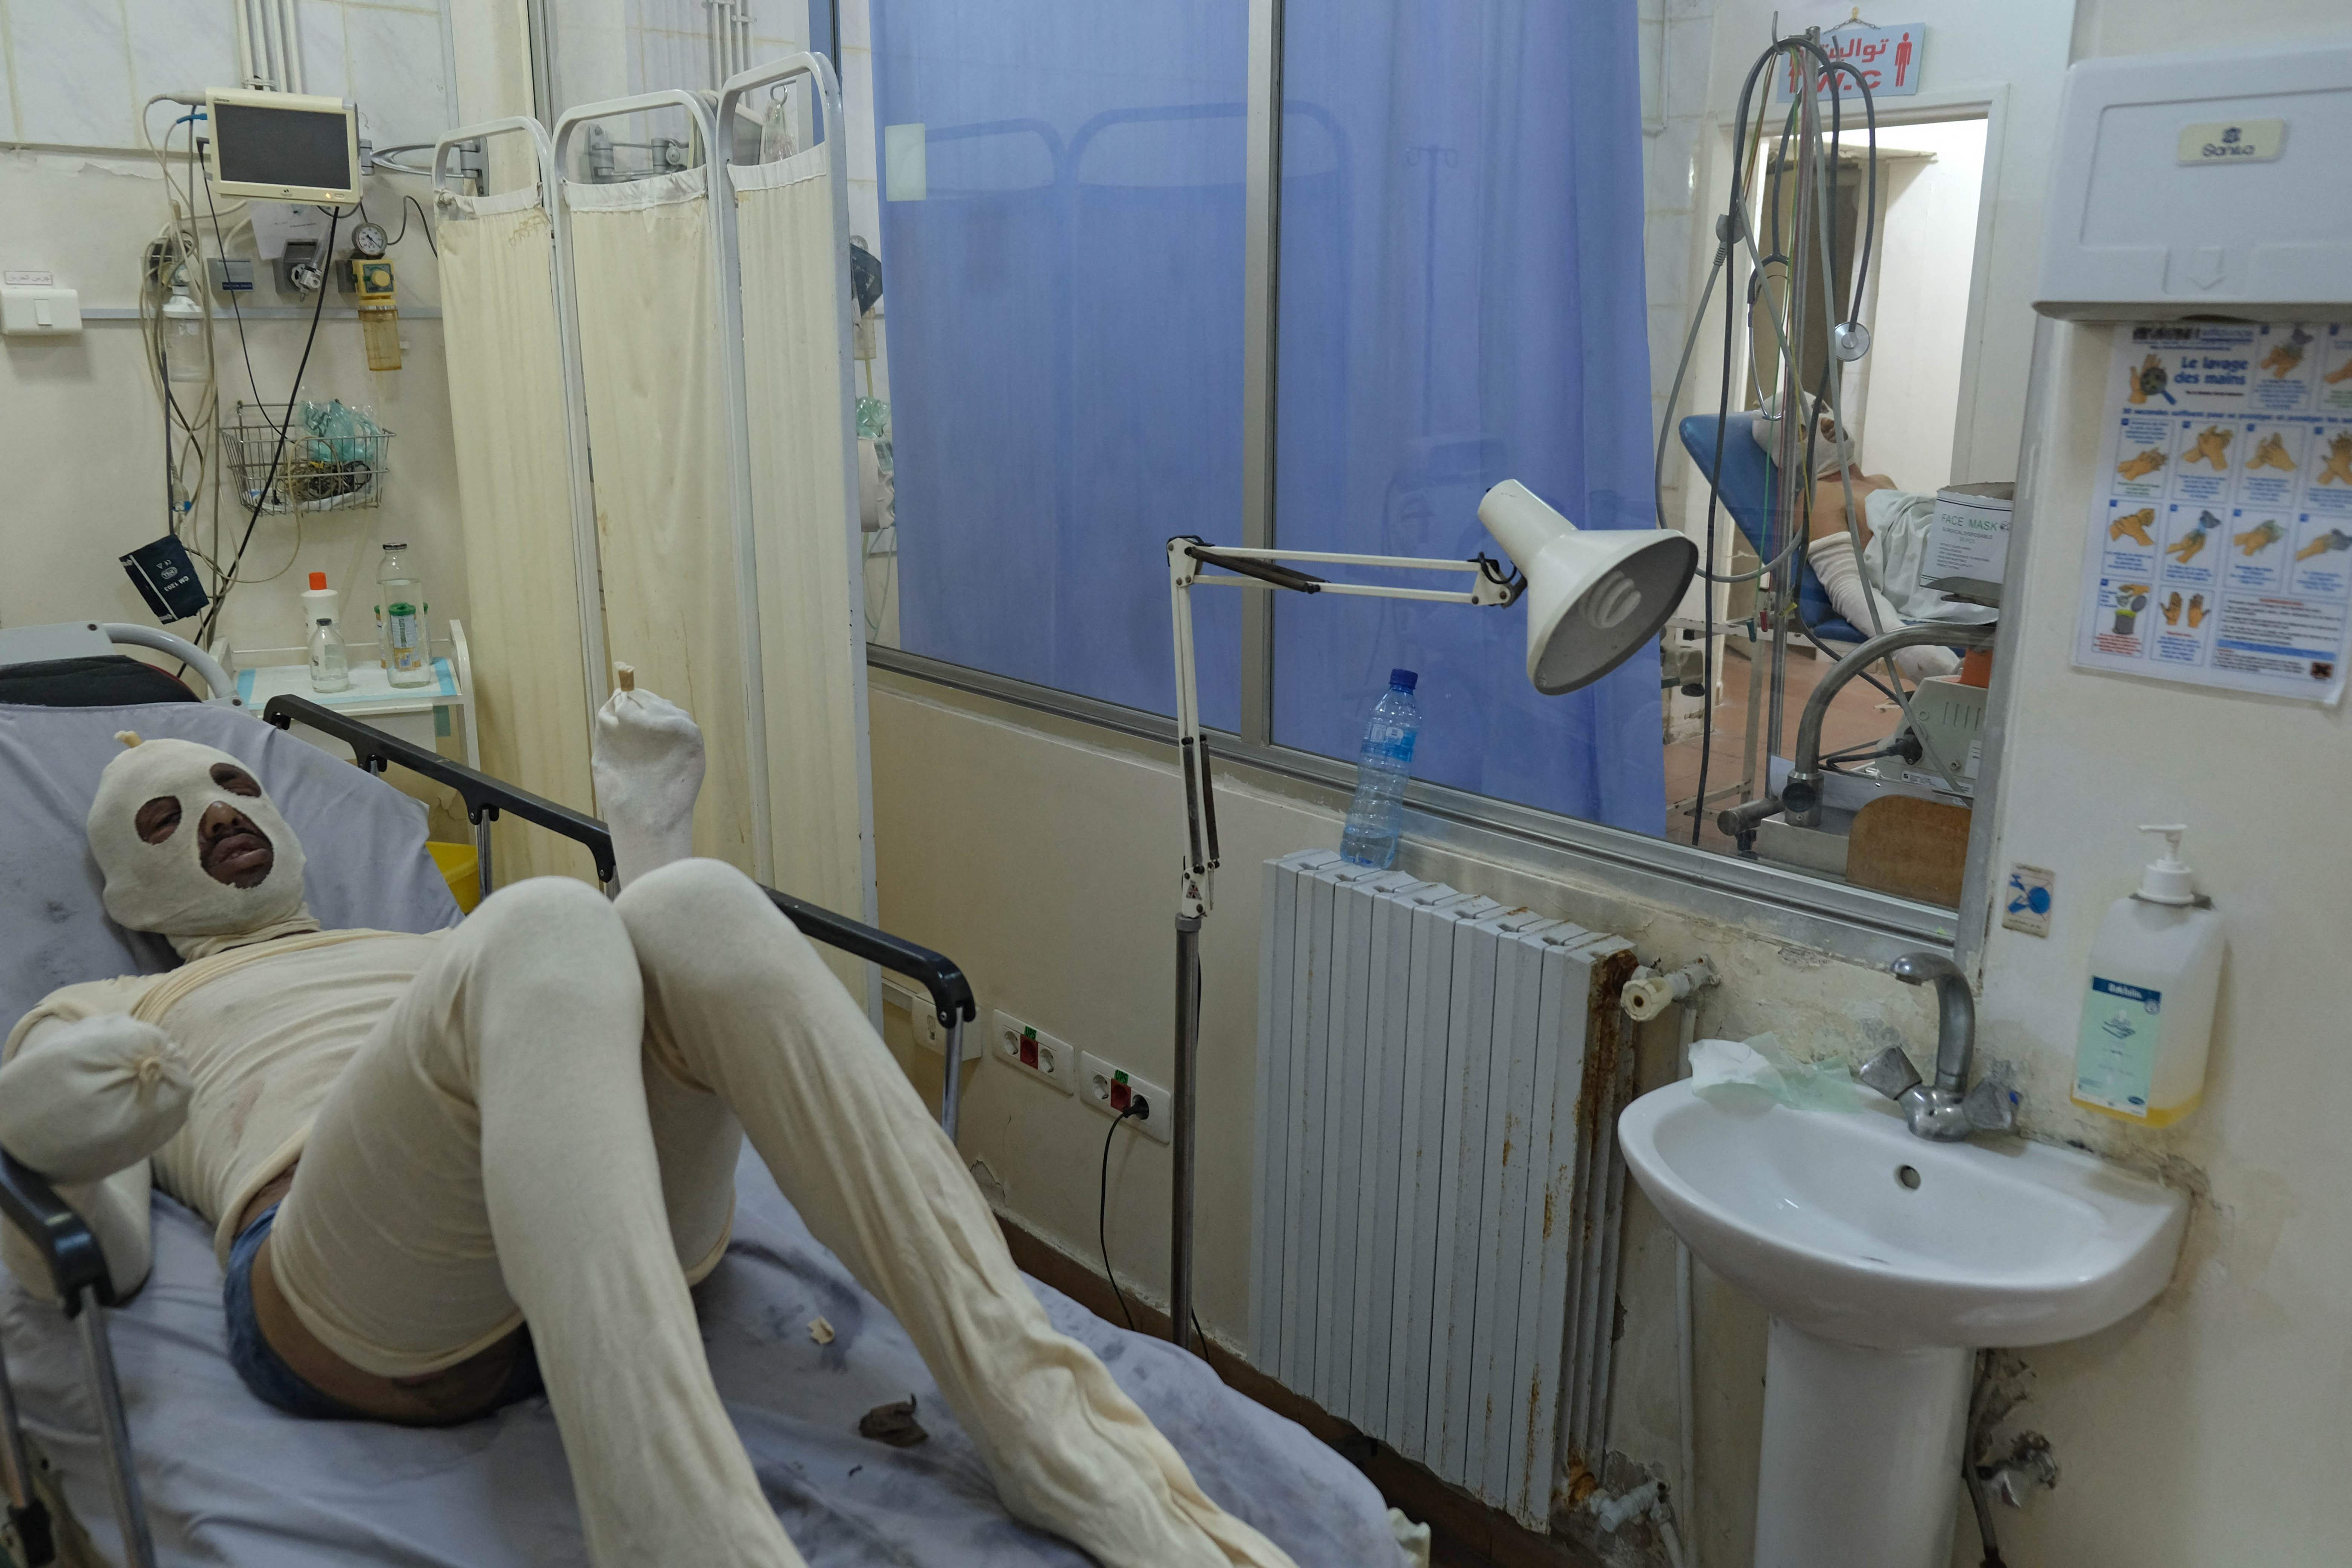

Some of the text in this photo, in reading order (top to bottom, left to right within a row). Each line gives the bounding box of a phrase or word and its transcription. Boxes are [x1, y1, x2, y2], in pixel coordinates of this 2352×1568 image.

[2181, 356, 2249, 373] Le lavage
[2174, 371, 2246, 386] des mains
[1942, 513, 1998, 531] FACE MASK
[1963, 531, 1993, 540] DISPOSABLE
[1025, 1026, 1036, 1039] UPS
[1115, 1070, 1127, 1084] UPS
